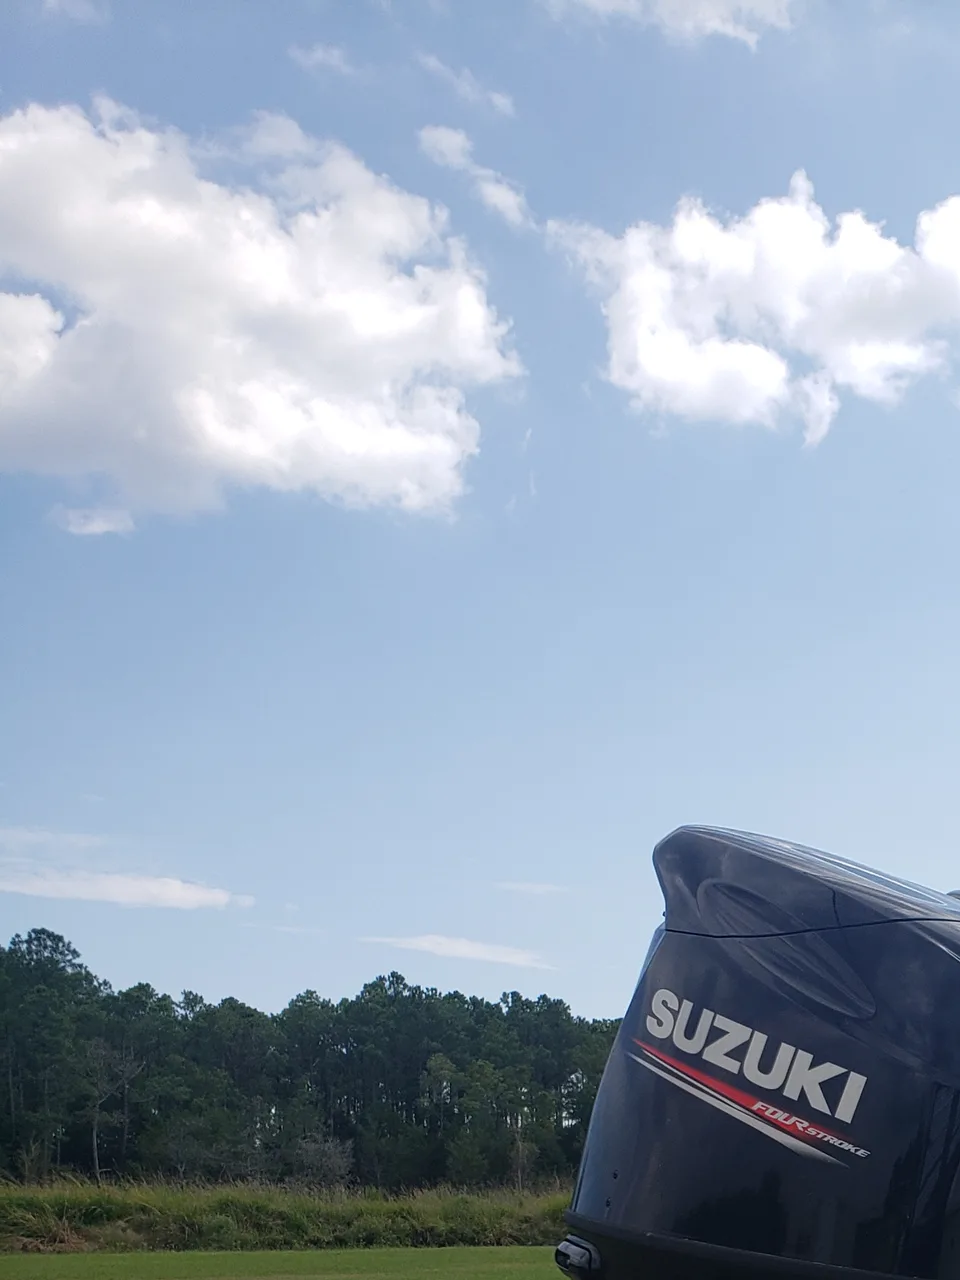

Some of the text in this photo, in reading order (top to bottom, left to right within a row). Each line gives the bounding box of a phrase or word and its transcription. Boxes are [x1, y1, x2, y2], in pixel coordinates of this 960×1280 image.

[646, 988, 868, 1124] SUZUKI
[751, 1101, 871, 1158] FOUR STROKE
